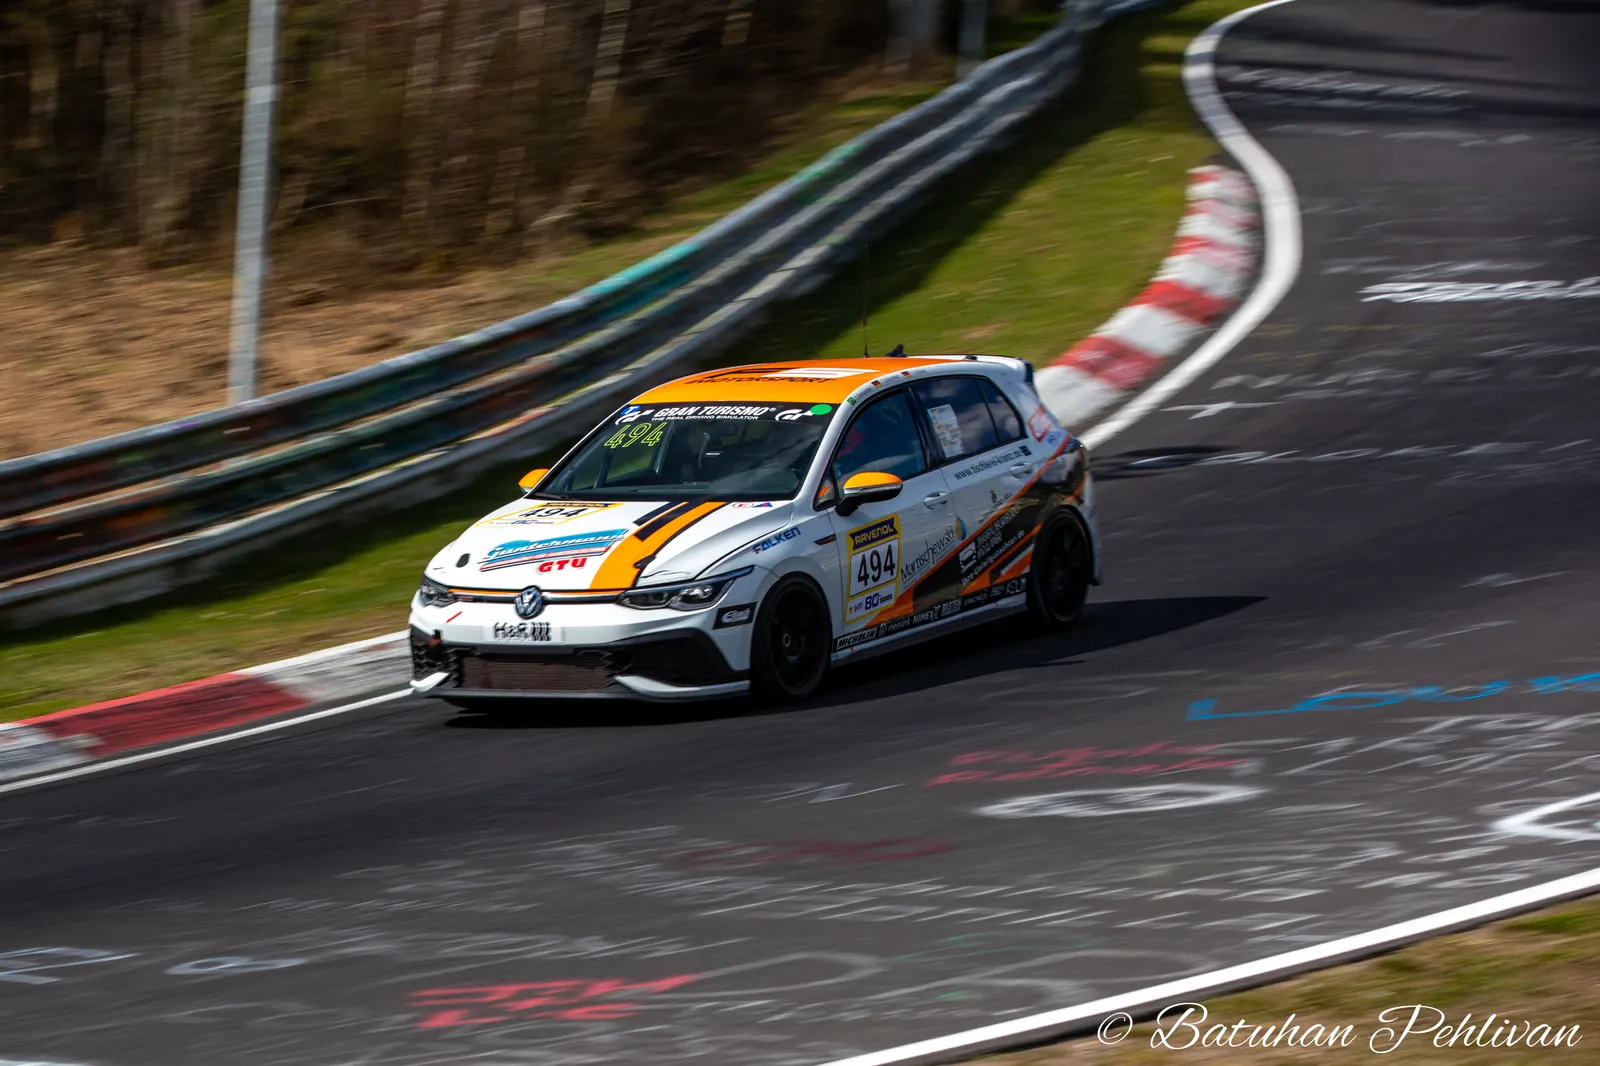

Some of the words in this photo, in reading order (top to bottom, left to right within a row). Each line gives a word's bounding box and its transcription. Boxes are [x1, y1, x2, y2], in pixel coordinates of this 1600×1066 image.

[653, 406, 695, 418] GRAN
[603, 421, 669, 449] 494
[519, 507, 589, 518] 494
[752, 526, 801, 555] FALKEN
[854, 523, 894, 546] RAVENOL
[857, 543, 896, 587] 494
[900, 525, 956, 582] Martischewski
[837, 630, 876, 648] MICHELIN
